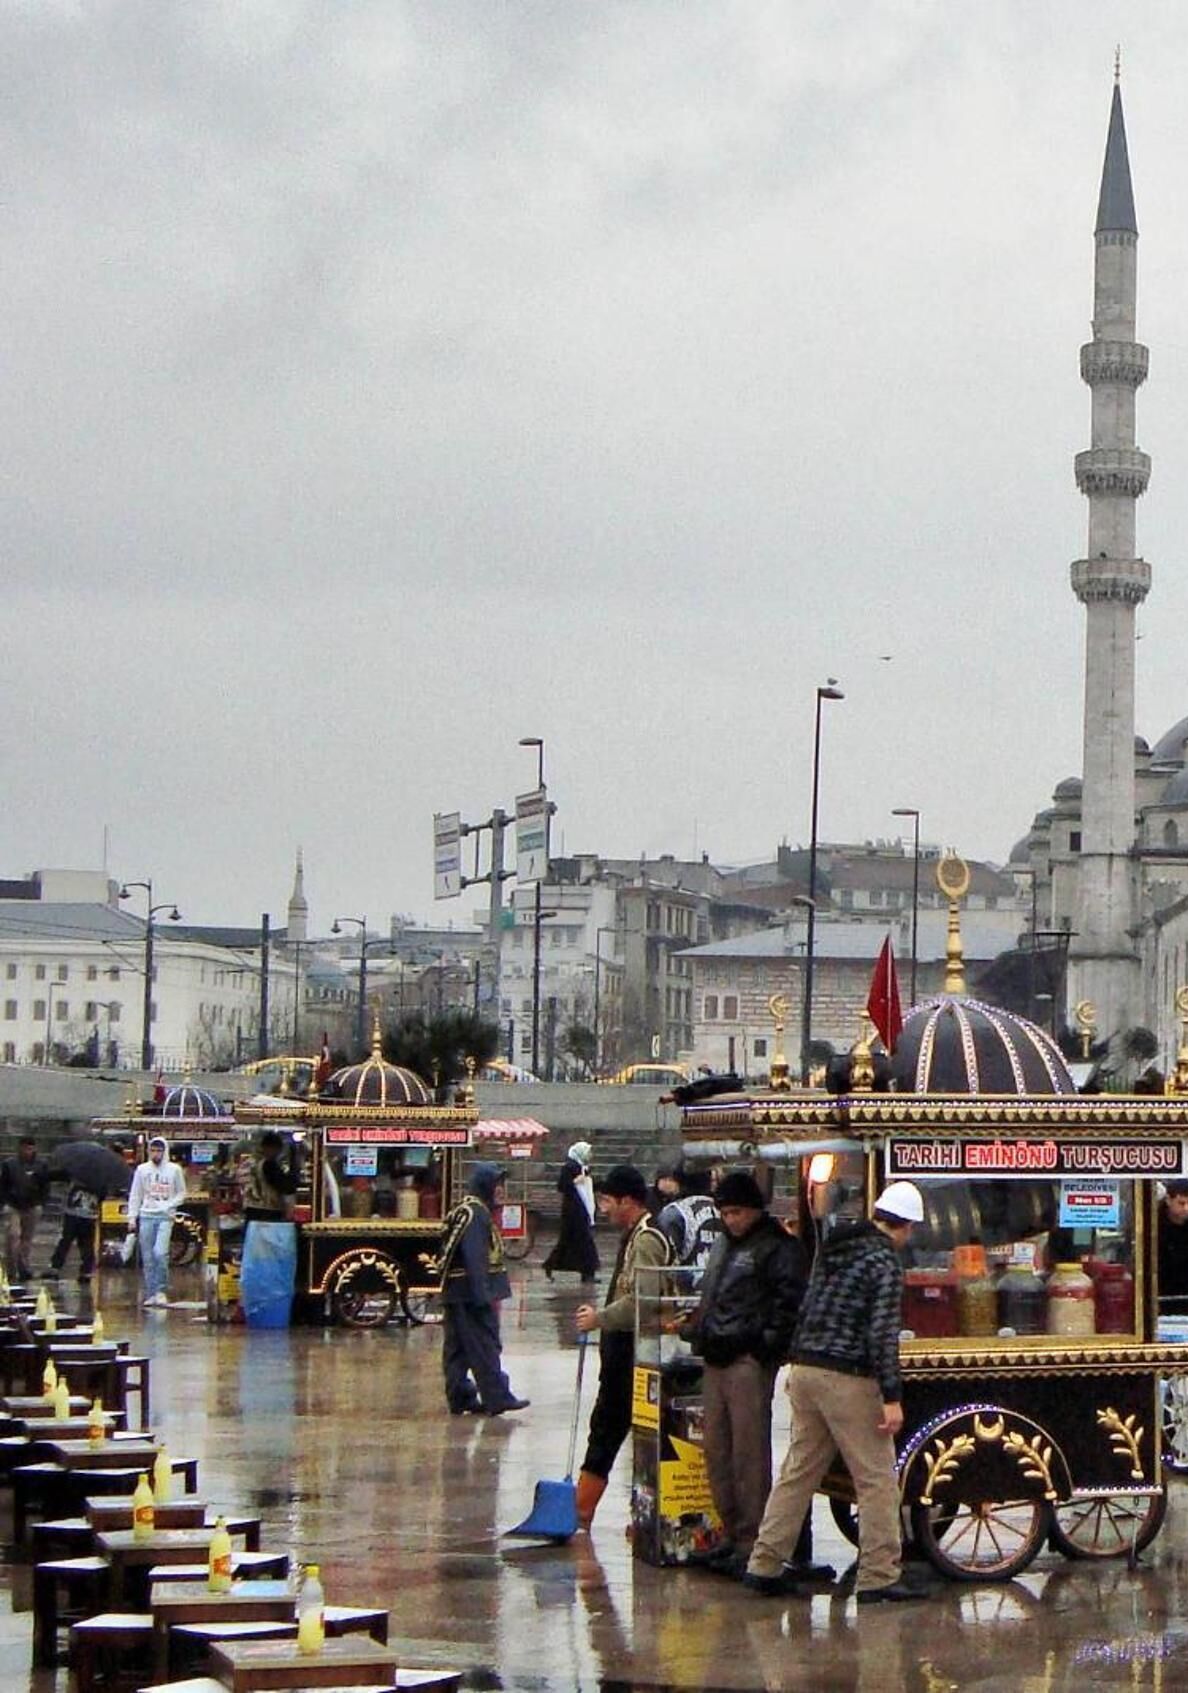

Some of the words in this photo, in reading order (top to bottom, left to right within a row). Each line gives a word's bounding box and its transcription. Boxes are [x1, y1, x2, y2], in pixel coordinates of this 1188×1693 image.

[894, 1140, 961, 1168] TARİHİ
[965, 1138, 1057, 1168] EMİNÖNÜ
[1061, 1145, 1178, 1173] TURŞUCUSU
